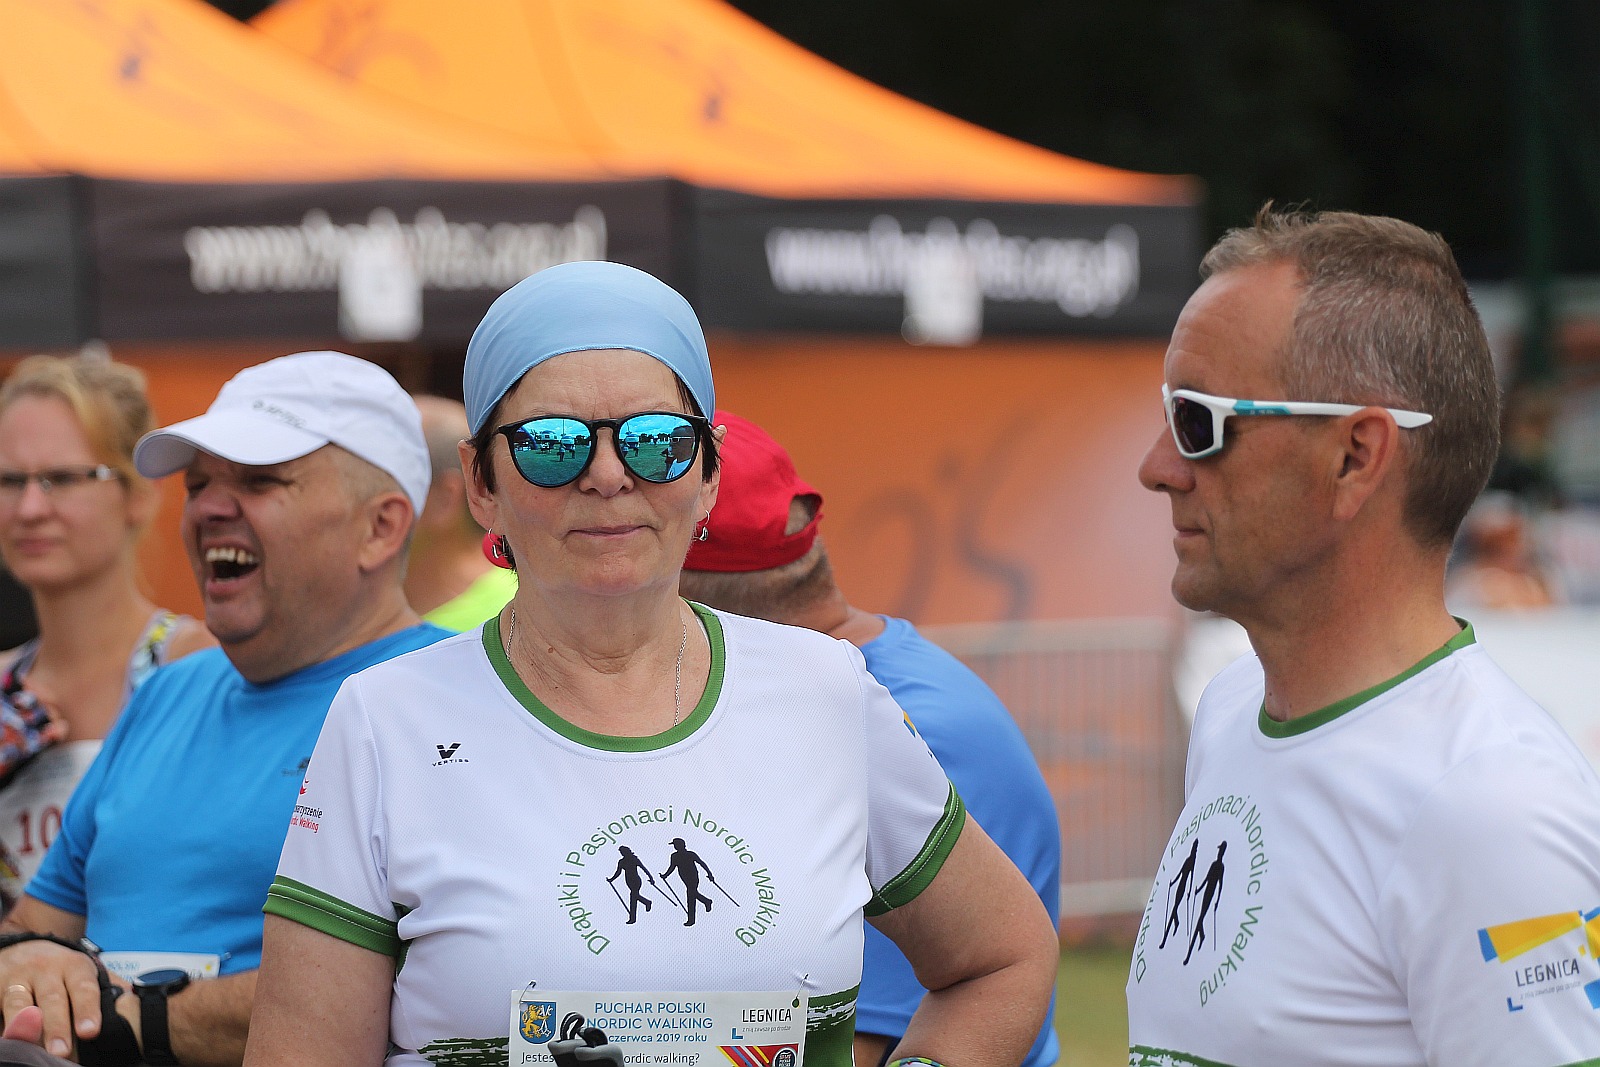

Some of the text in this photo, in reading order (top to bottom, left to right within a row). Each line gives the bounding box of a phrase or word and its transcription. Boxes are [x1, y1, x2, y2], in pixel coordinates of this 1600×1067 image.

[566, 805, 673, 867] Pasjonaci
[683, 808, 754, 865] Nordic
[1170, 795, 1250, 858] Pasjonaci
[1241, 804, 1269, 895] Nordic
[557, 884, 610, 955] Drapiki
[735, 867, 781, 947] Walking
[1199, 905, 1263, 1007] Walking
[1515, 958, 1580, 987] LEGNICA
[587, 1017, 713, 1029] NORDIC WALKING
[594, 1002, 706, 1014] PUCHAR POLSKI
[742, 1008, 792, 1023] LEGNICA
[608, 1032, 707, 1043] czerwca 2019 roku
[623, 1052, 651, 1064] ordic
[654, 1052, 700, 1067] walking?
